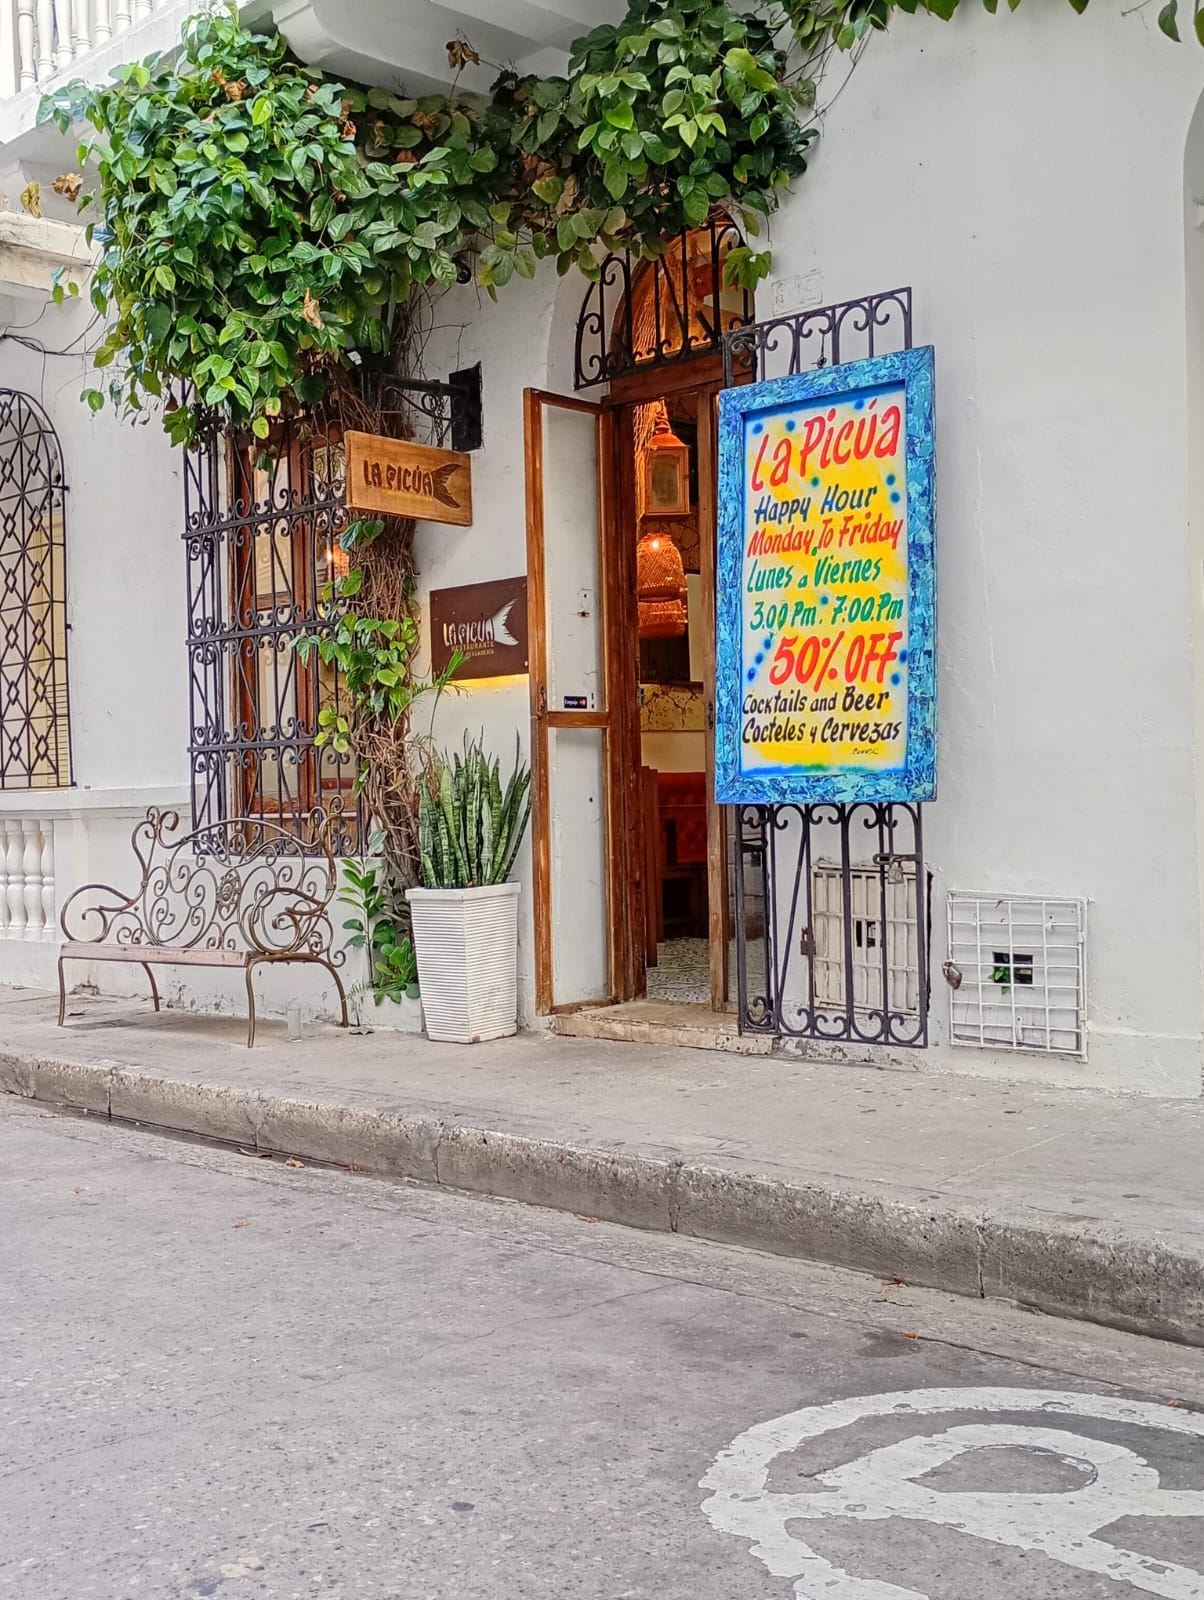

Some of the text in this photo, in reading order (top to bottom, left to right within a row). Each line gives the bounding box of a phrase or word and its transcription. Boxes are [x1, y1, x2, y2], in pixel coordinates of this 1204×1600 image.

[751, 398, 901, 492] La Picúa
[363, 459, 433, 496] LA PICÚA
[754, 484, 878, 525] Happy Hour
[747, 512, 904, 558] Monday To Friday
[747, 555, 883, 593] Lunes a Viernes
[443, 622, 457, 647] LA
[451, 641, 495, 652] RESTAURANTE
[769, 631, 903, 693] 50% OFF
[742, 685, 890, 714] Cocktails and Beer
[742, 716, 903, 744] Cocteles y Cervezas
